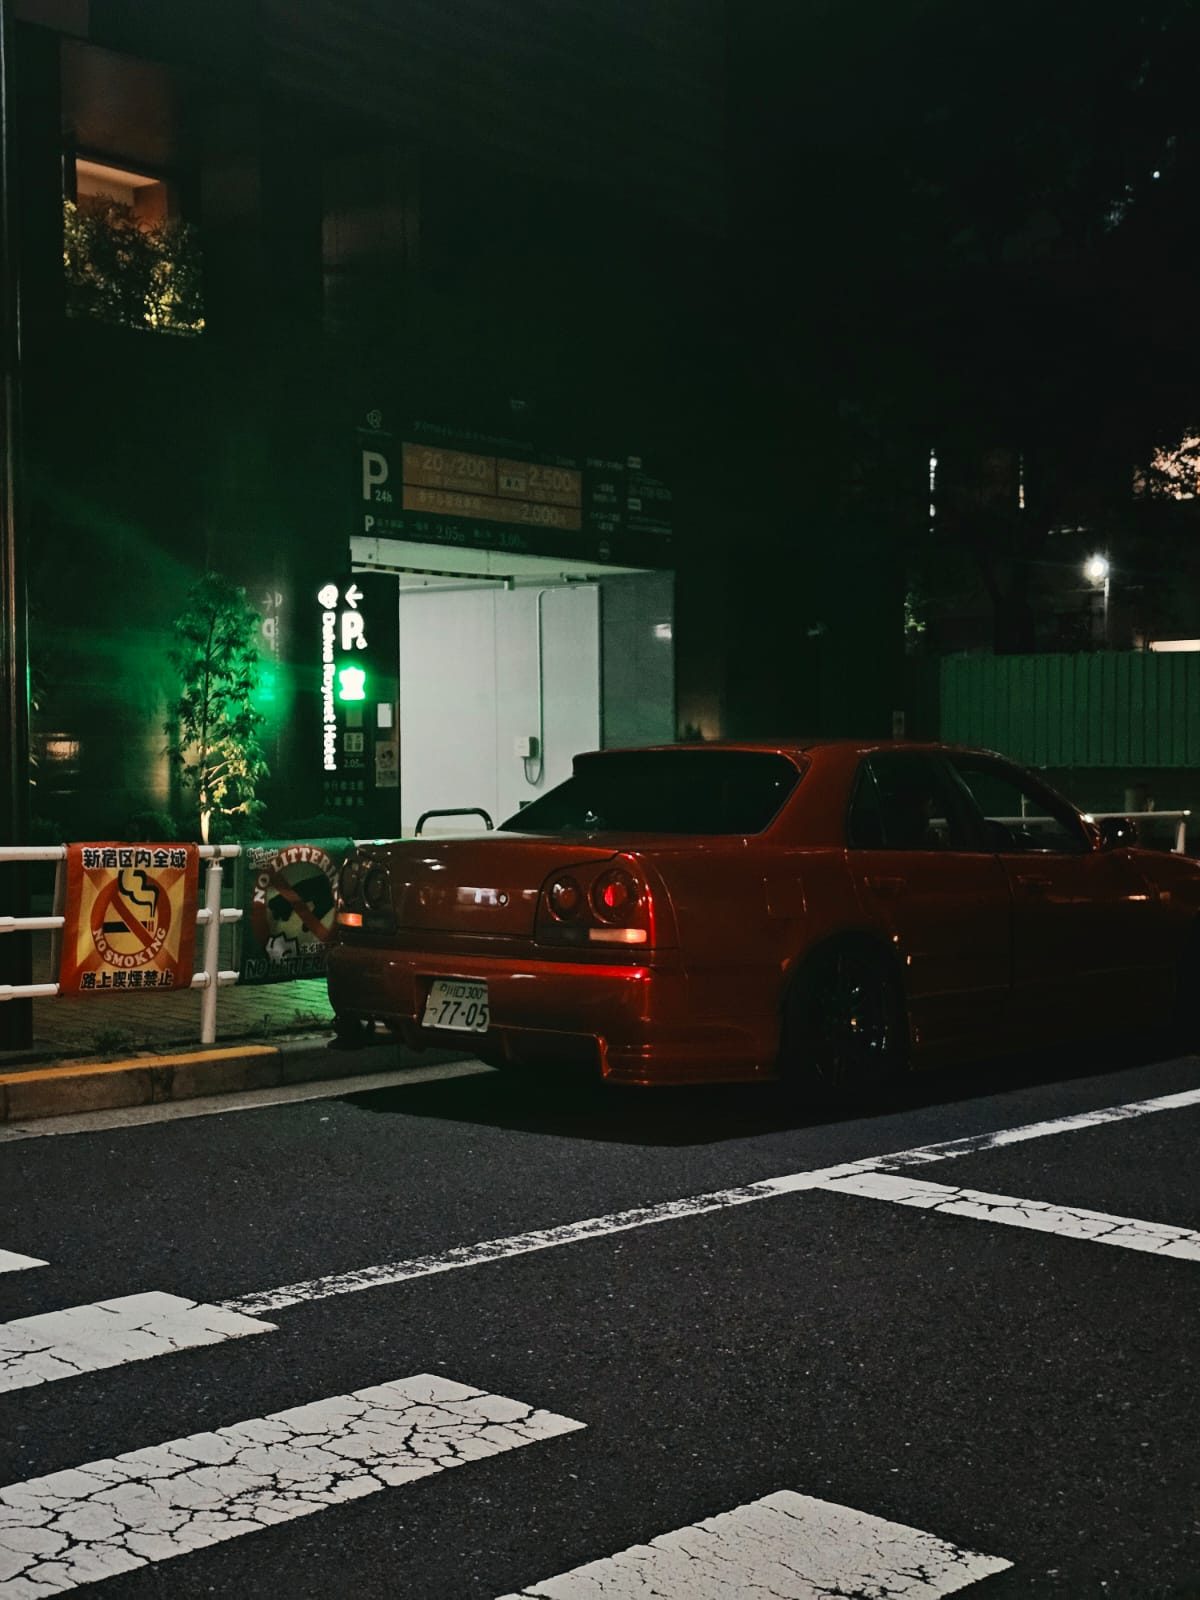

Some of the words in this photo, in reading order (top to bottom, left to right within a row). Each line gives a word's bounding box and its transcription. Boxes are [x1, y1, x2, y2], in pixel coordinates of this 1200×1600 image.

[362, 450, 388, 500] P
[323, 724, 337, 770] Hotel
[82, 848, 186, 868] 新宿区内全域
[253, 874, 270, 904] NO
[92, 930, 106, 952] NO
[103, 928, 167, 967] SMOKING
[80, 970, 173, 990] 路上喫煙禁止
[465, 986, 483, 1000] 300
